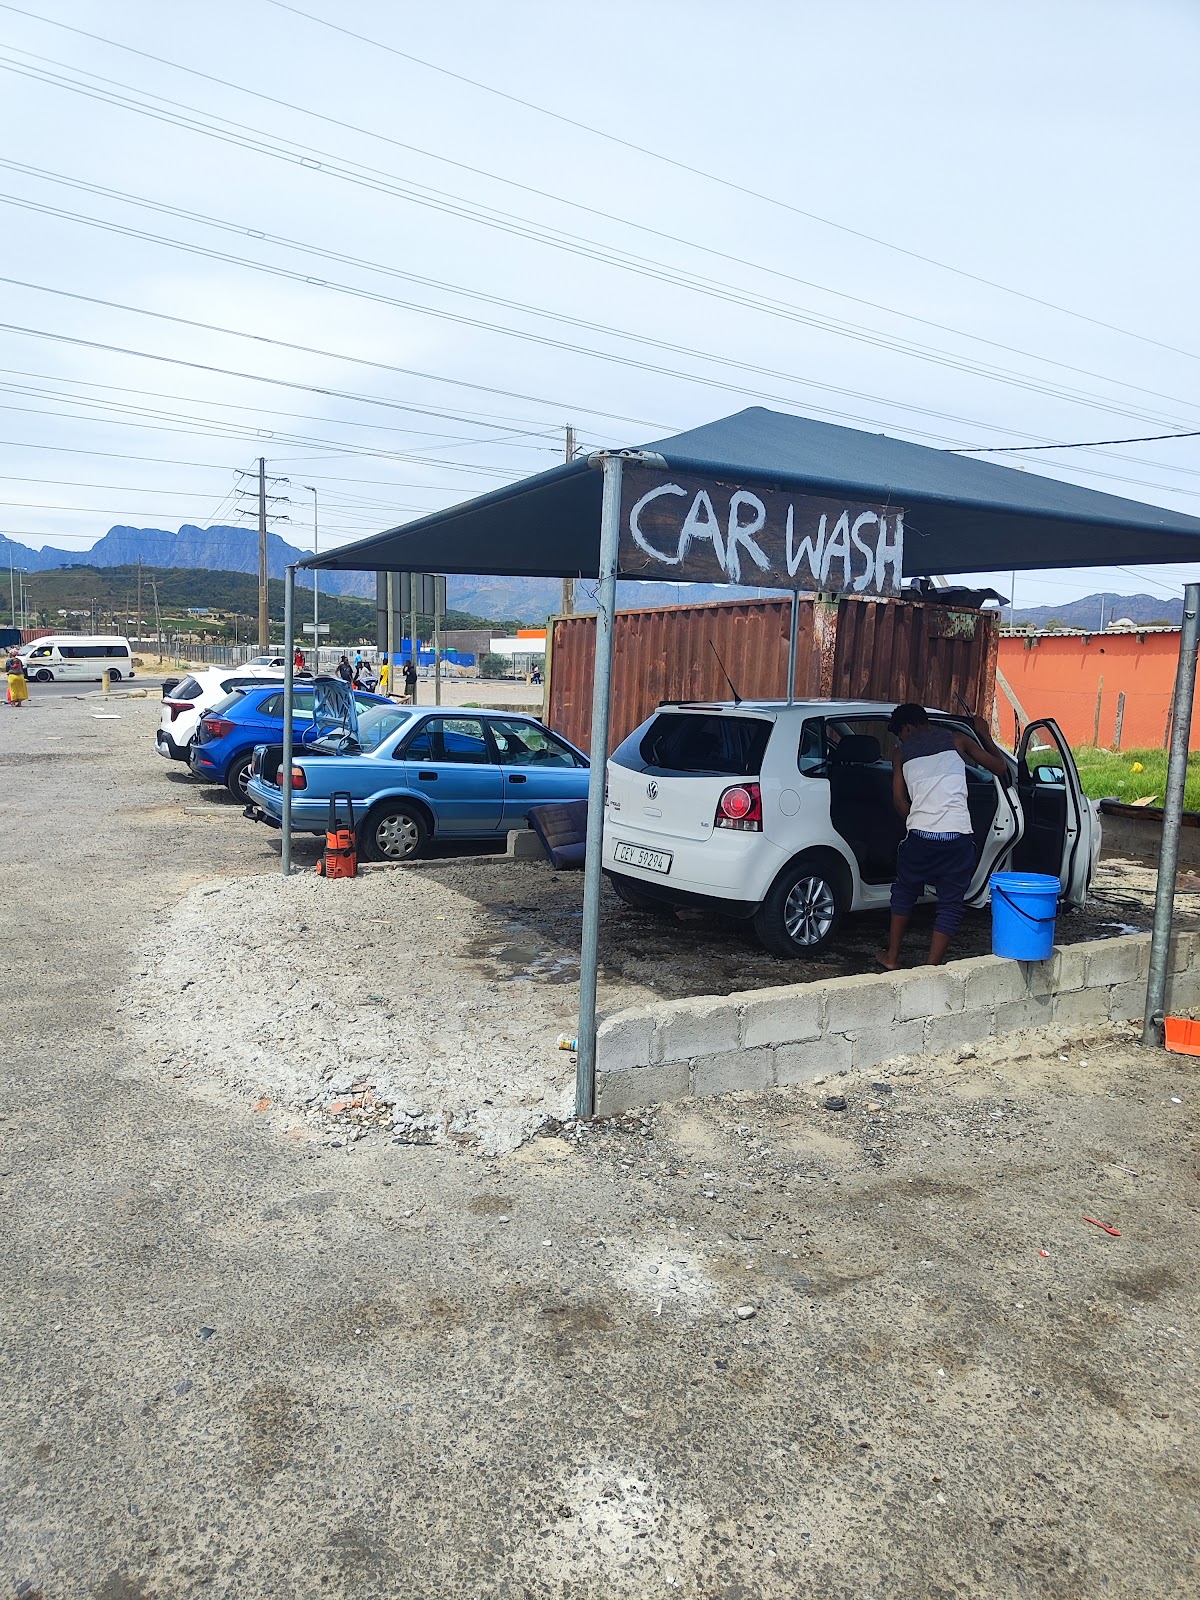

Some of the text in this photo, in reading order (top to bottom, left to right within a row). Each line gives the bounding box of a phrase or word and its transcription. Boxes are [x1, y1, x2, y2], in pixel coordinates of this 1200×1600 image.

[630, 482, 904, 593] CAR WASH
[620, 846, 663, 868] CEY 59294
